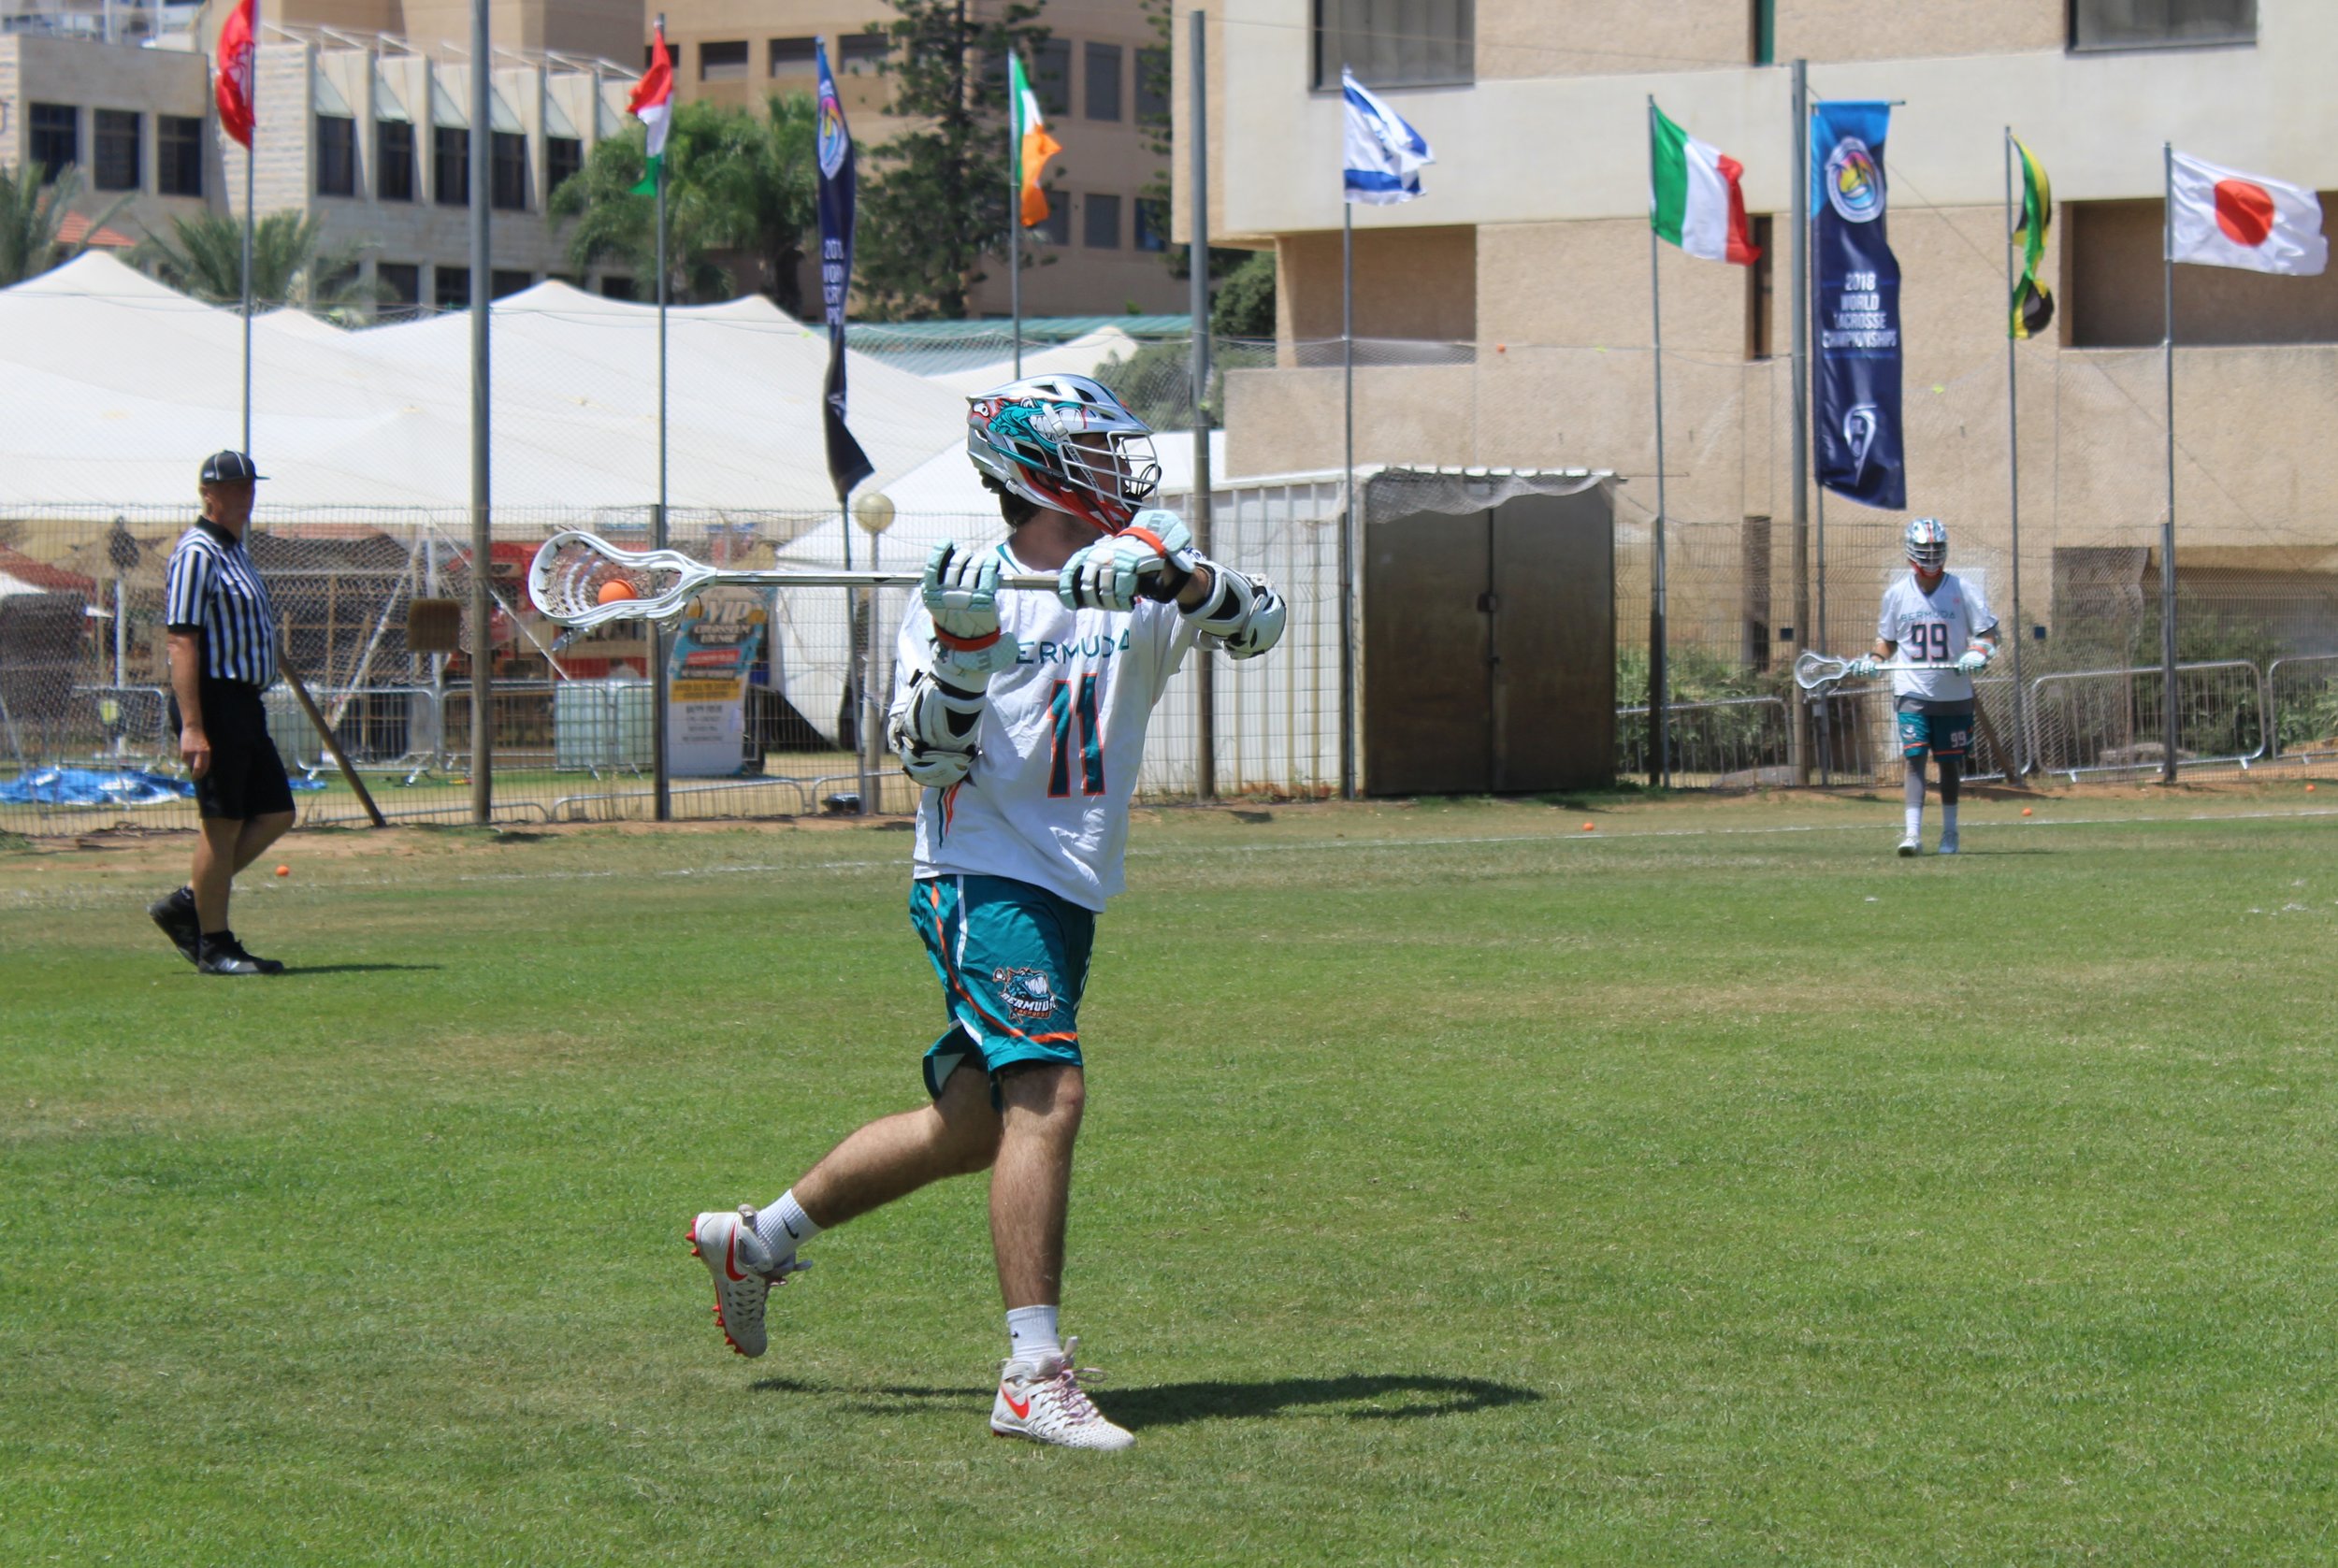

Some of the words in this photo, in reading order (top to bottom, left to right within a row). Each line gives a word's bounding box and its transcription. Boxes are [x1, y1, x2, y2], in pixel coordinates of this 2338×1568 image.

[1844, 271, 1877, 292] 2018
[1840, 293, 1880, 311] WORLD
[1899, 610, 1957, 622] BERMUDA
[1015, 627, 1131, 666] ERMUDA
[1911, 623, 1950, 663] 99
[1046, 672, 1106, 798] 11
[1950, 730, 1968, 748] 99
[999, 992, 1058, 1012] BERMUDA
